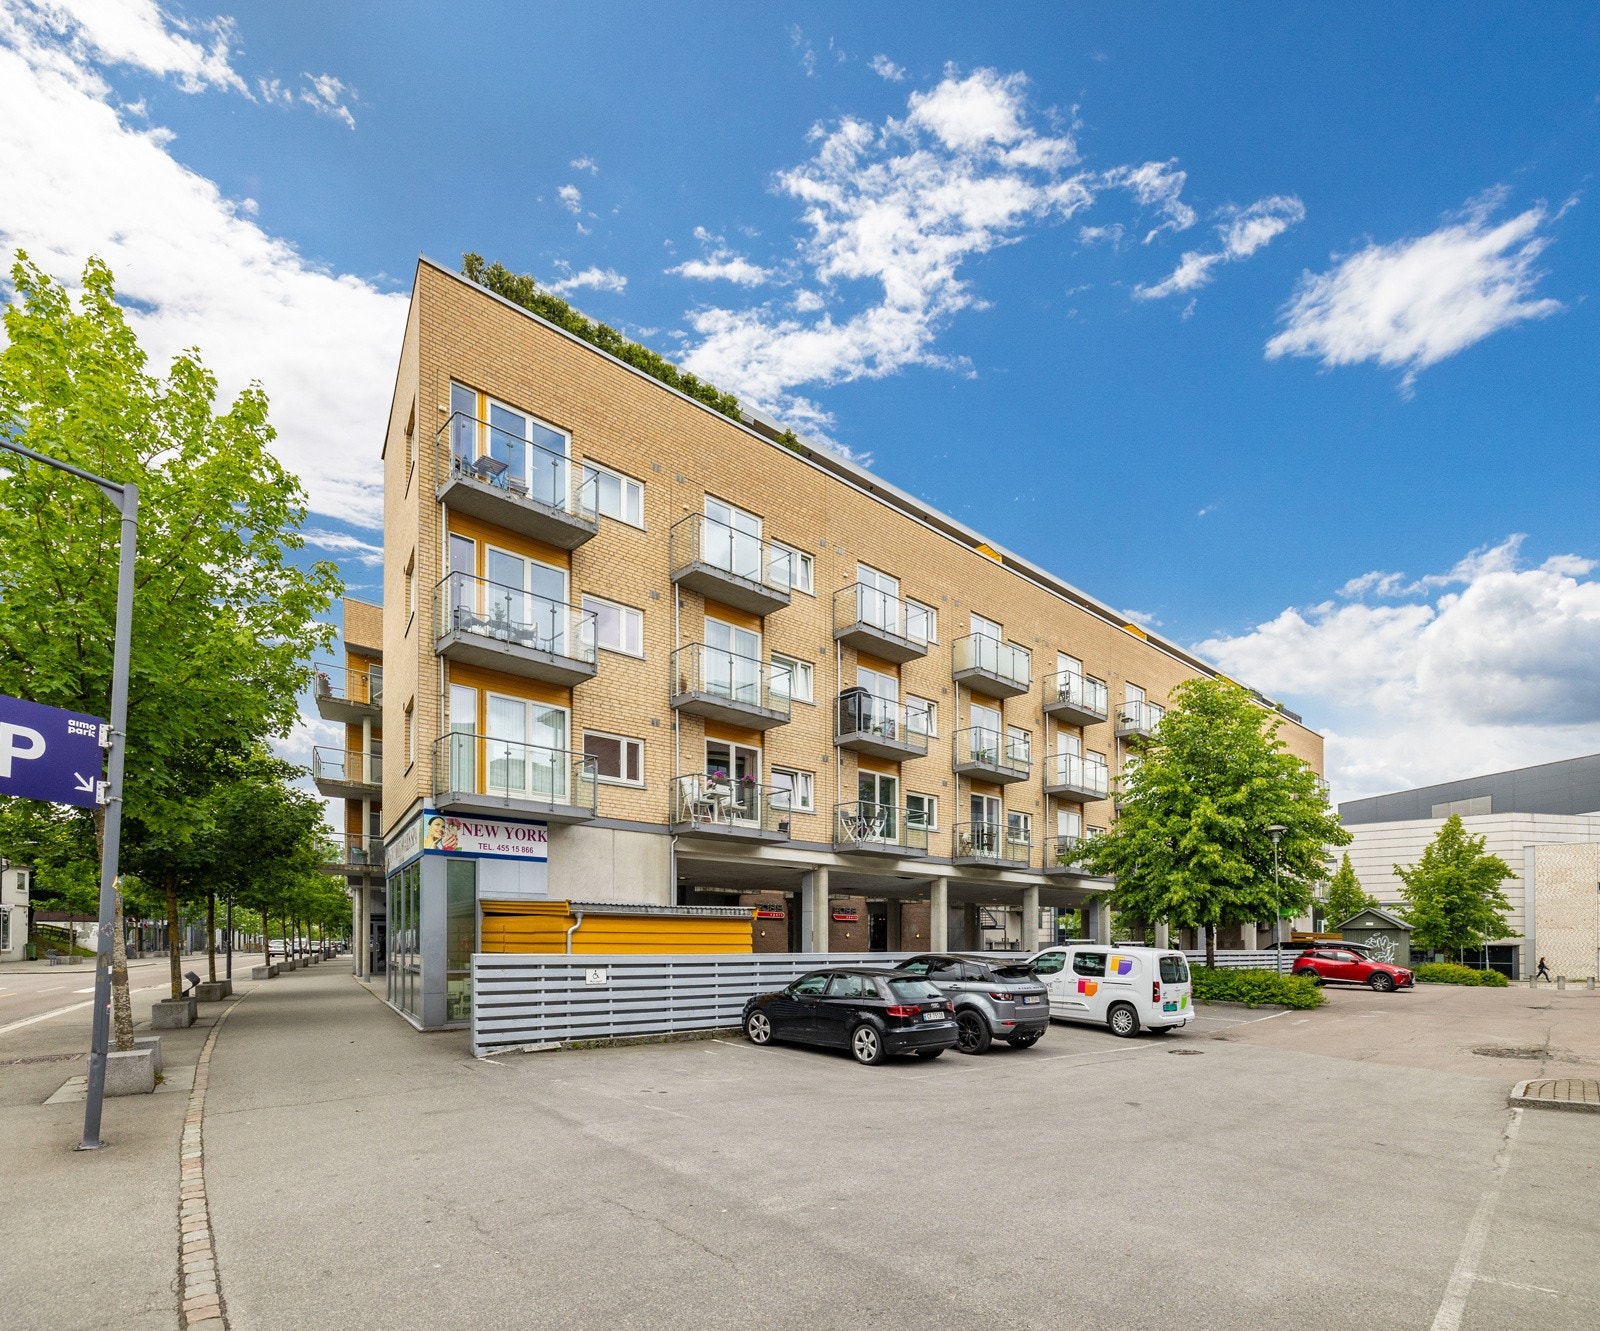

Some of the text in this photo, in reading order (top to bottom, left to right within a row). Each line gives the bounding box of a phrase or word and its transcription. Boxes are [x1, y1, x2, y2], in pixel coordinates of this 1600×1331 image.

[68, 719, 97, 730] aimo
[68, 726, 96, 738] park
[0, 722, 46, 778] P
[462, 823, 548, 842] NEW YORK
[478, 843, 495, 851] TEL.
